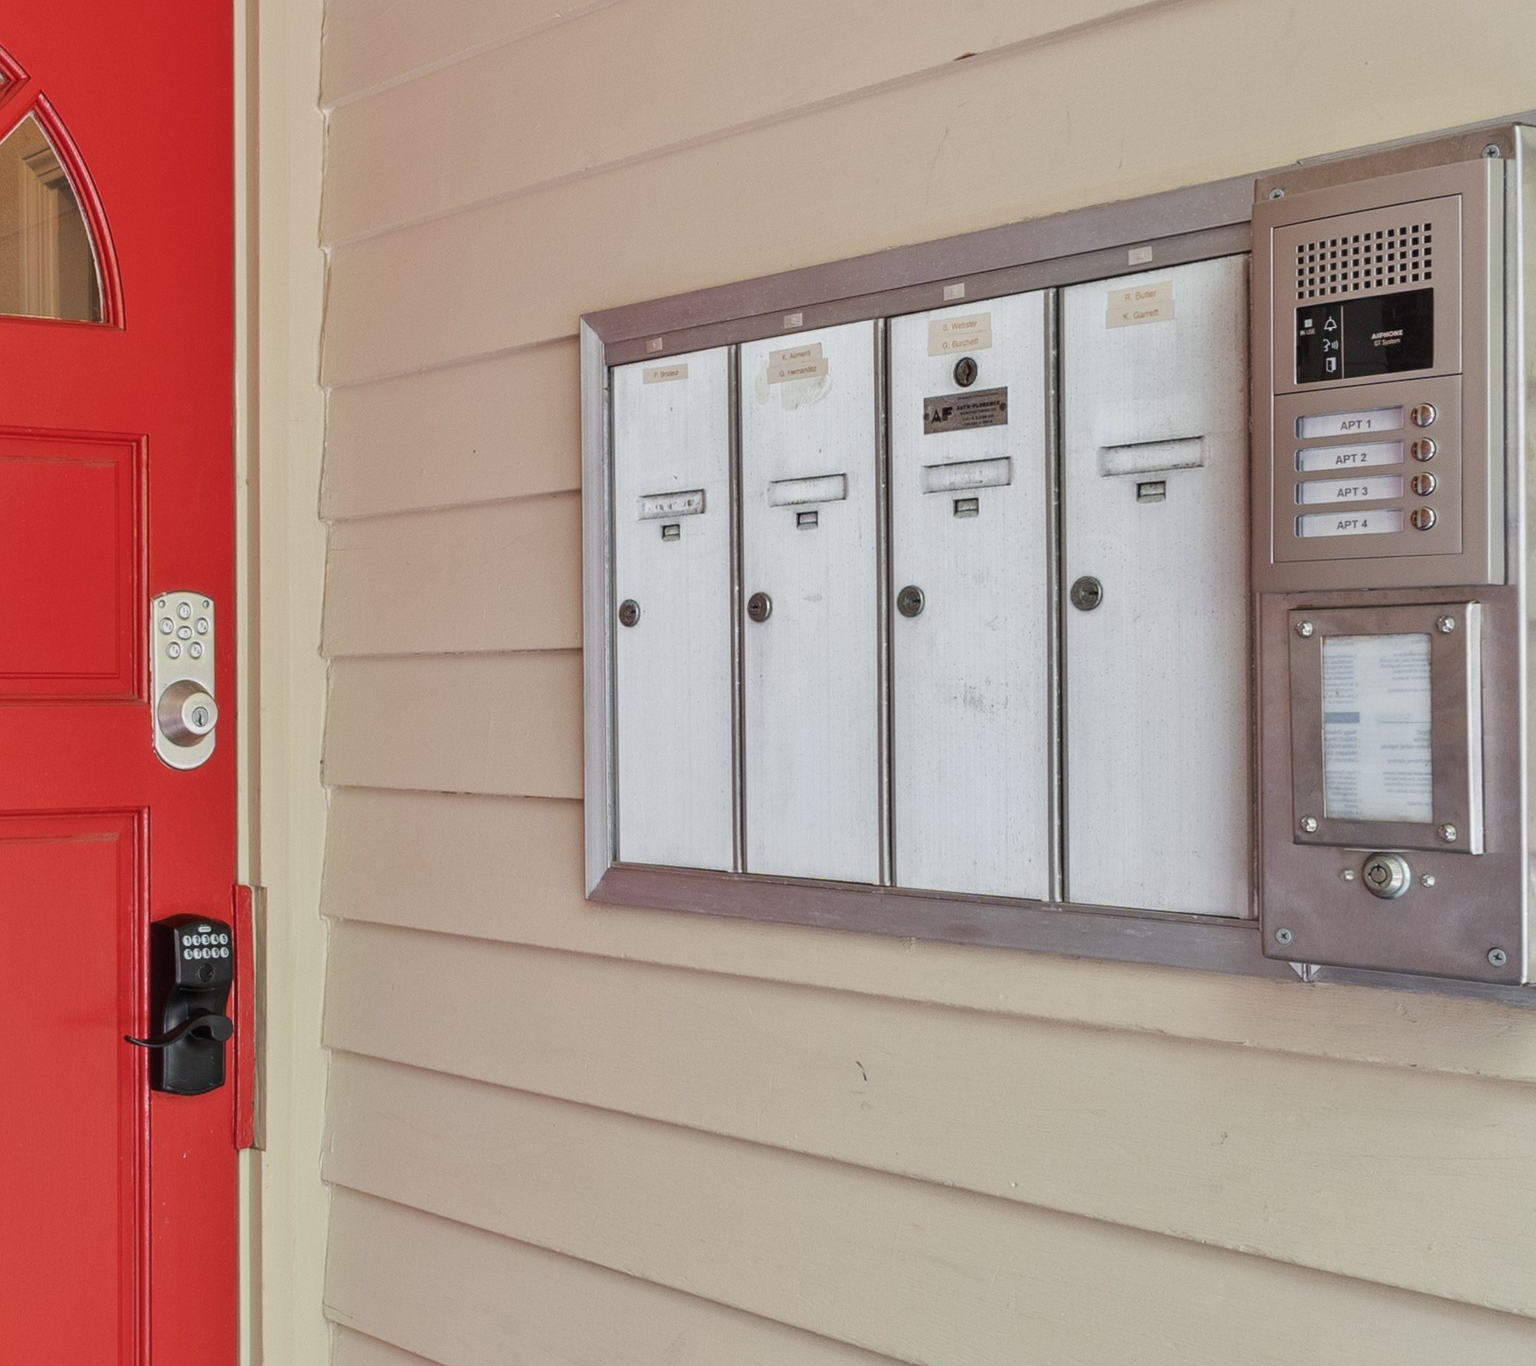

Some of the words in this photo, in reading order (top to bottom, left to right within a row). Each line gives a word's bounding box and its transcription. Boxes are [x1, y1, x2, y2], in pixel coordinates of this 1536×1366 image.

[1340, 420, 1363, 430] APT
[1366, 419, 1371, 428] 1
[1335, 454, 1357, 464] APT
[1360, 453, 1367, 462] 2
[1337, 487, 1358, 497] APT
[1362, 487, 1368, 496] 3
[1337, 520, 1358, 530] APT
[1361, 519, 1368, 528] 4
